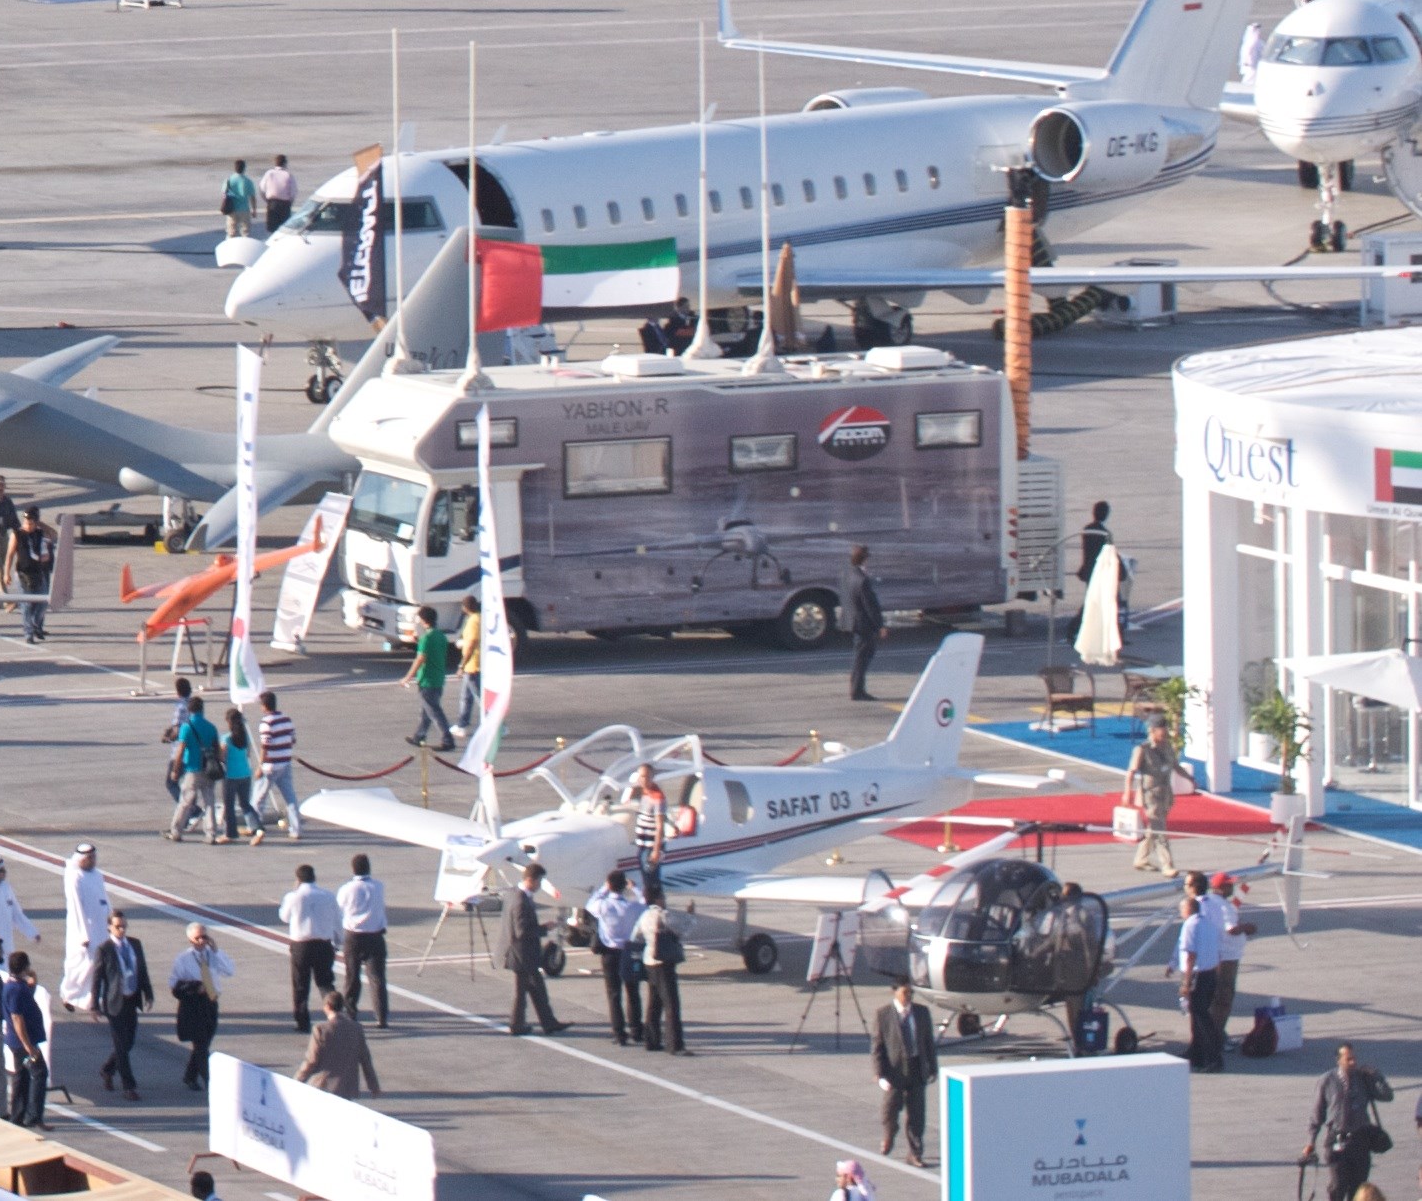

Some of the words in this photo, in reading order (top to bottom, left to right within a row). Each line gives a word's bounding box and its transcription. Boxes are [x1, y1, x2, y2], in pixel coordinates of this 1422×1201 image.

[1204, 414, 1300, 487] Quest
[766, 795, 820, 820] SAFAT
[829, 790, 852, 810] 03
[1031, 1170, 1131, 1188] MUBADALA
